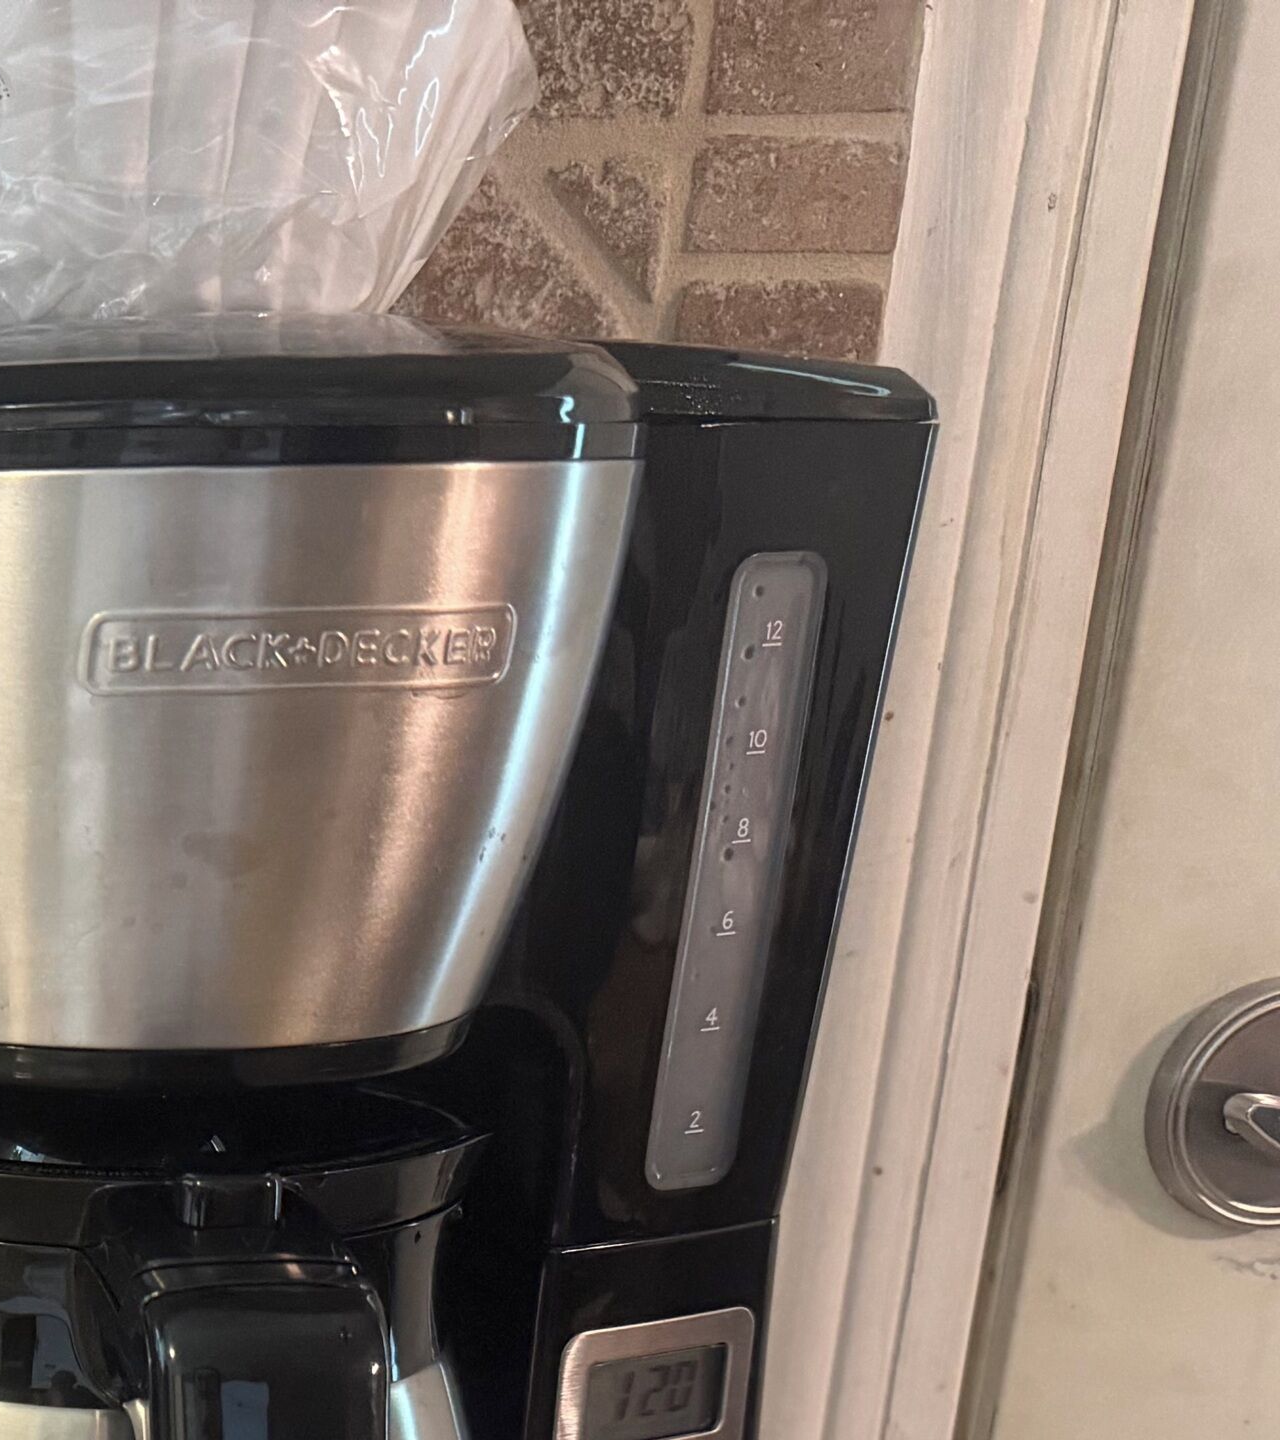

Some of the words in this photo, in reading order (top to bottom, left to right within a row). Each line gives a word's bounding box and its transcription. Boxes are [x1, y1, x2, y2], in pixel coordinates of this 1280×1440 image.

[766, 620, 783, 641] 12
[107, 624, 497, 672] BLACK+DECKER
[748, 730, 767, 749] 10
[737, 818, 749, 838] 8
[722, 911, 733, 931] 6
[705, 1007, 718, 1026] 4
[689, 1110, 700, 1129] 2
